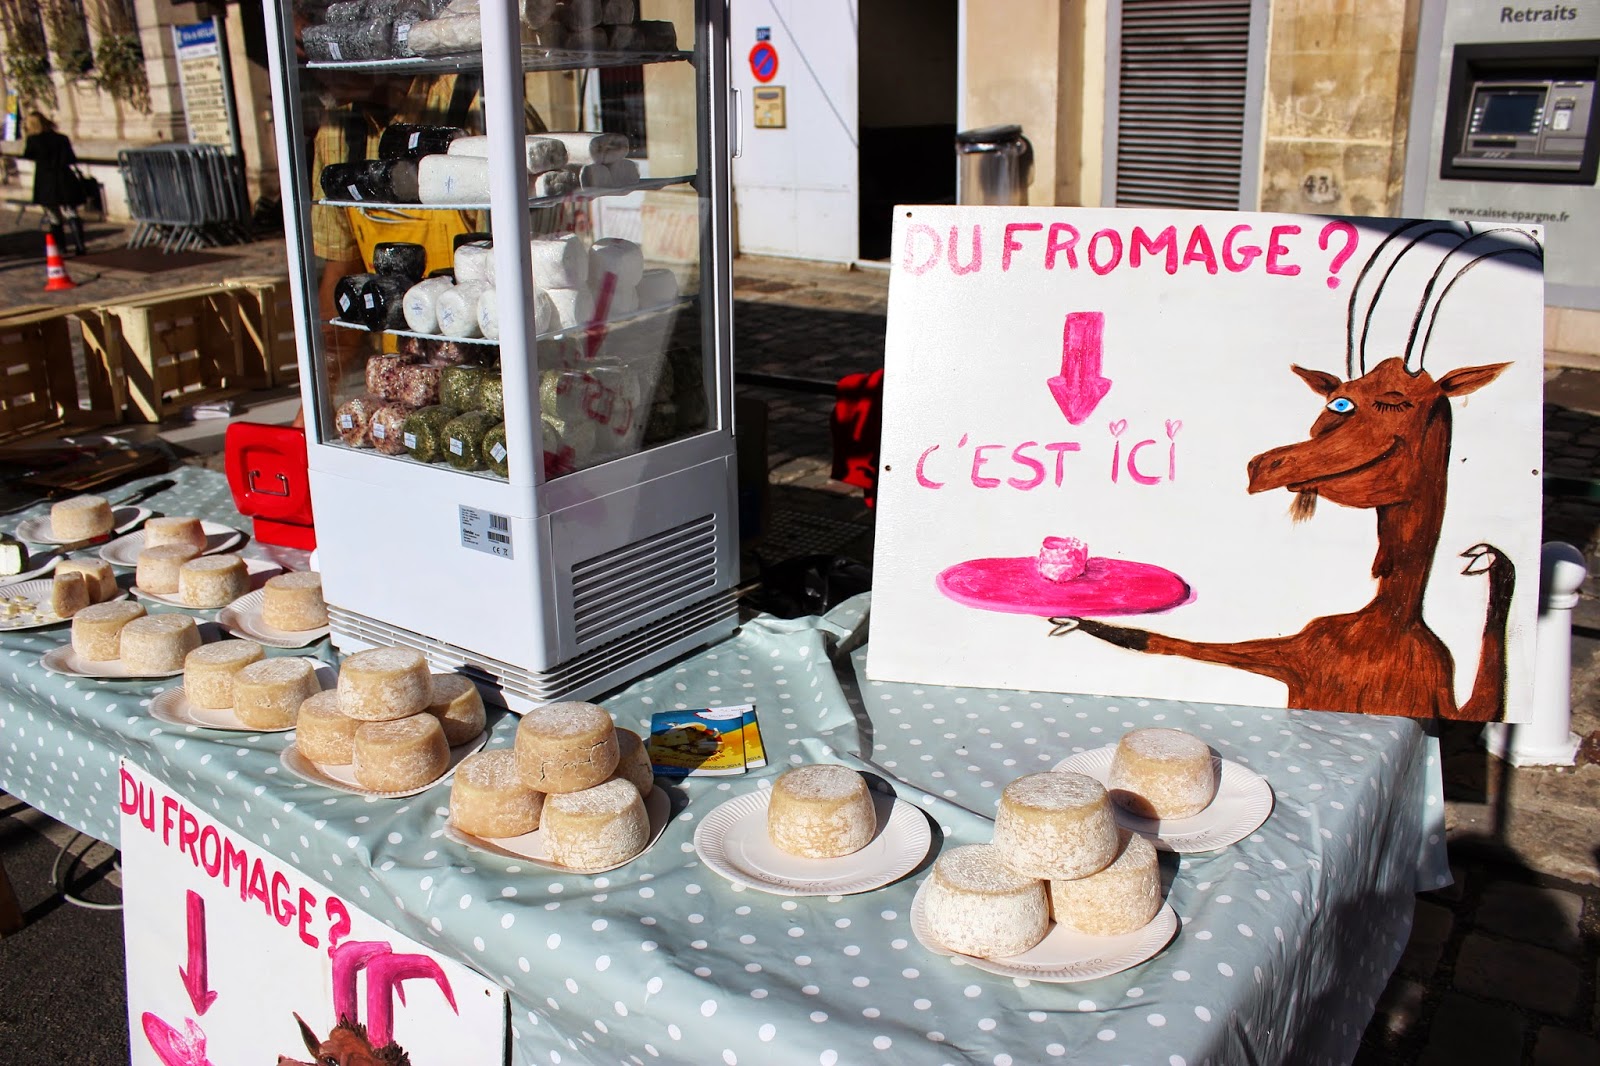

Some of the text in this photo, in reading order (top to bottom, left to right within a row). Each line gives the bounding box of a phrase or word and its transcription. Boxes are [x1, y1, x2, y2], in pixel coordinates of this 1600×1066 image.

[1500, 4, 1577, 23] Retraits
[1448, 206, 1570, 223] www.caisse-epargne.fr
[903, 223, 983, 276] DU
[916, 432, 1082, 491] C'EST
[119, 767, 155, 832] DU
